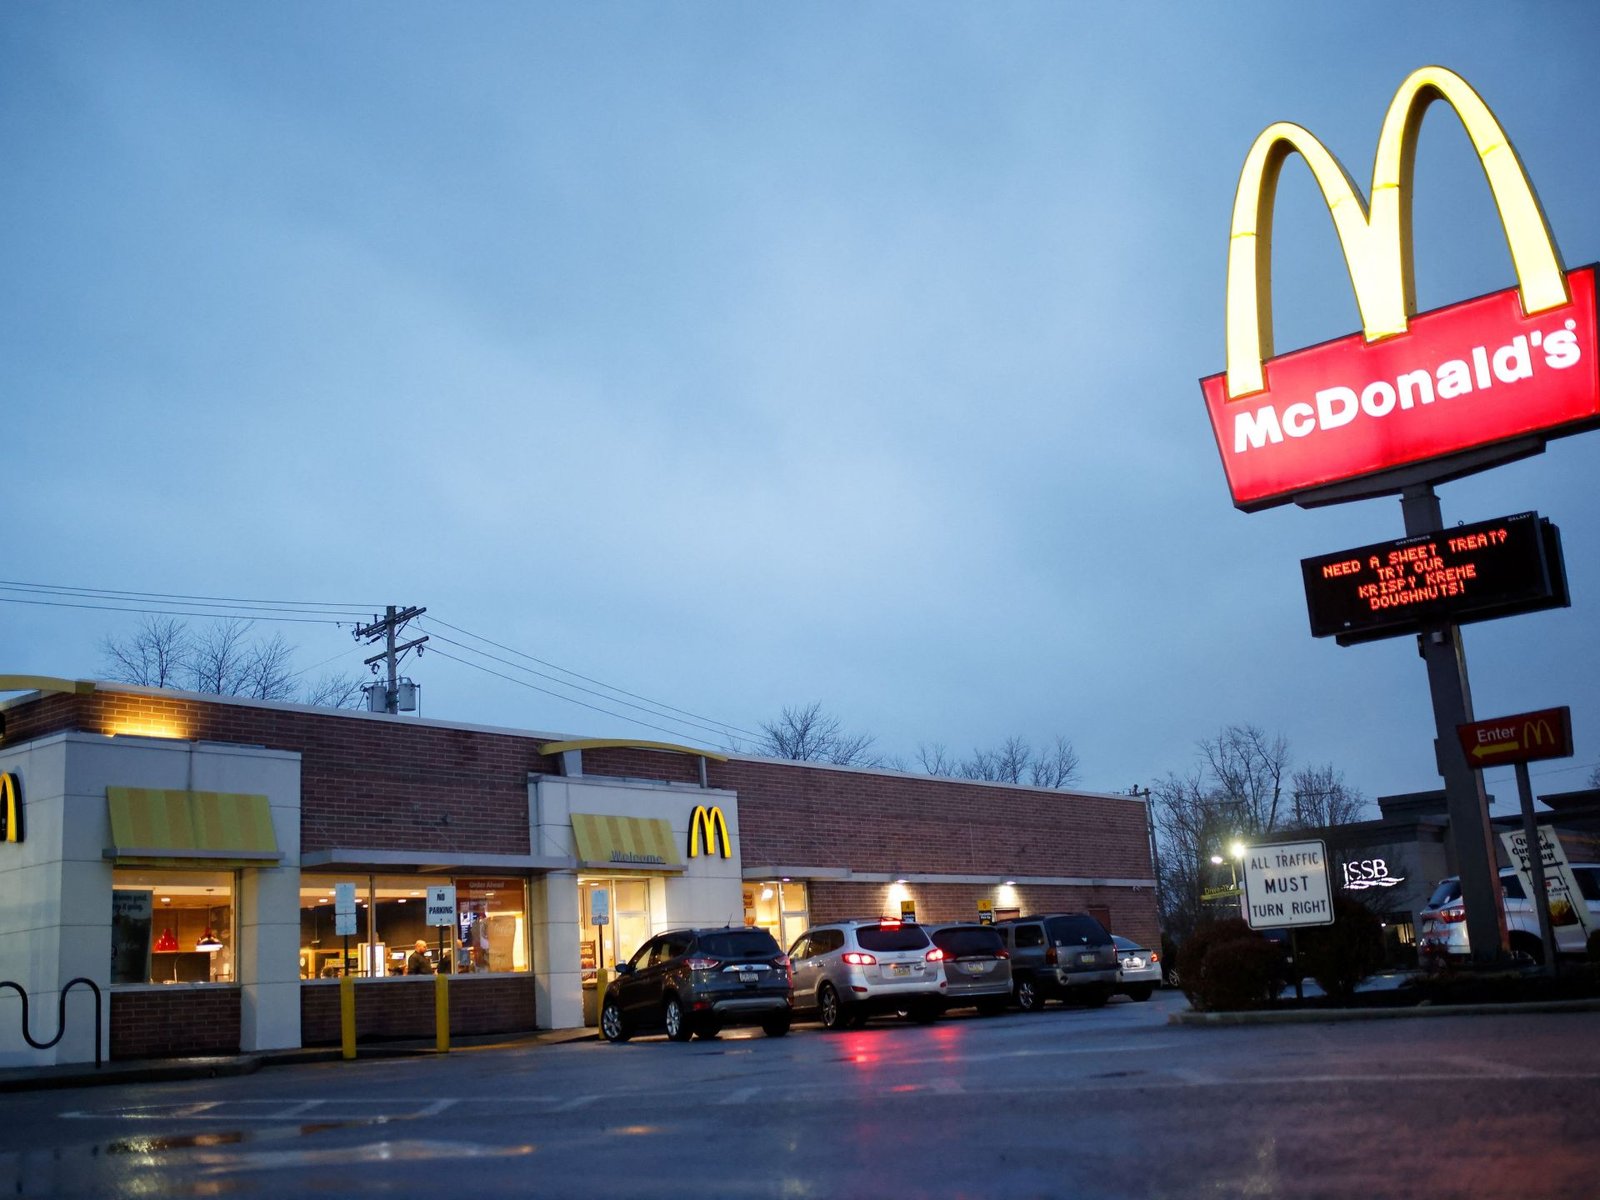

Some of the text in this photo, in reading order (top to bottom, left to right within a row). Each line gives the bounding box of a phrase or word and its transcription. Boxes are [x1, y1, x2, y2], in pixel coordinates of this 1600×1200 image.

[1233, 330, 1582, 454] McDonald's
[1322, 528, 1508, 579] NEED A SWEET TREAT?
[1377, 557, 1444, 580] TRY OUR
[1358, 564, 1477, 598] KRISPY KREME
[1369, 582, 1466, 610] DOUGHNUTS!
[1476, 727, 1516, 744] Enter
[611, 850, 664, 863] Welcome
[1251, 852, 1319, 870] ALL TRAFFIC
[1264, 876, 1309, 894] MUST
[436, 893, 446, 902] NO
[428, 906, 453, 915] PARKING
[1252, 899, 1327, 918] TURN RIGHT
